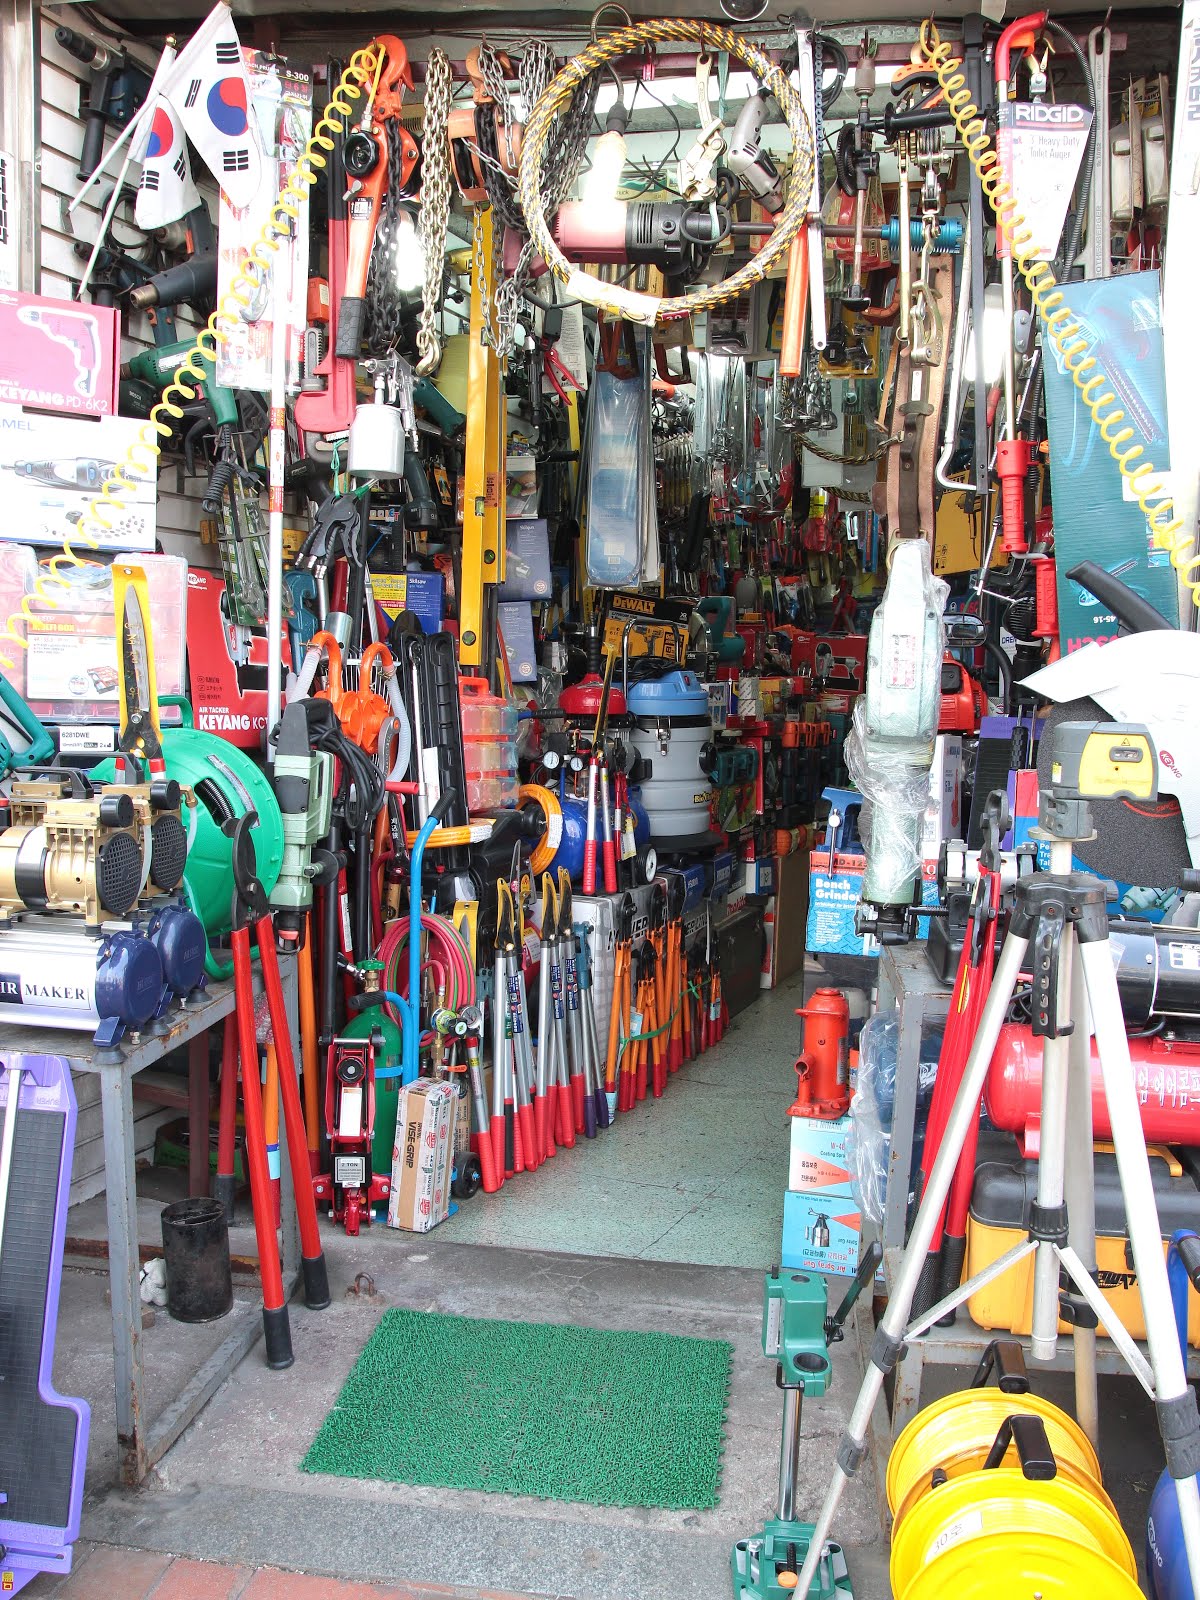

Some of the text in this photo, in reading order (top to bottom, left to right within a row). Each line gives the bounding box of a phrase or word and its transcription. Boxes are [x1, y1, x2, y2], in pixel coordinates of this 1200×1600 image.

[286, 70, 309, 82] S-300
[1016, 104, 1084, 122] RIDGID
[1038, 136, 1060, 147] Heavy
[1062, 137, 1080, 148] Duty
[1030, 148, 1071, 160] Toilet Auger
[0, 387, 108, 412] KEYANG PD-6K2
[2, 418, 37, 432] MEL
[209, 706, 230, 714] TACKER
[199, 714, 251, 731] KEYANG
[62, 731, 90, 739] 6281DWE
[1160, 752, 1183, 779] KEYANG
[815, 878, 851, 890] Bench
[0, 981, 86, 1000] IR MAKER
[803, 1260, 816, 1269] Gun
[817, 1260, 835, 1271] Spray
[837, 1265, 846, 1273] Air
